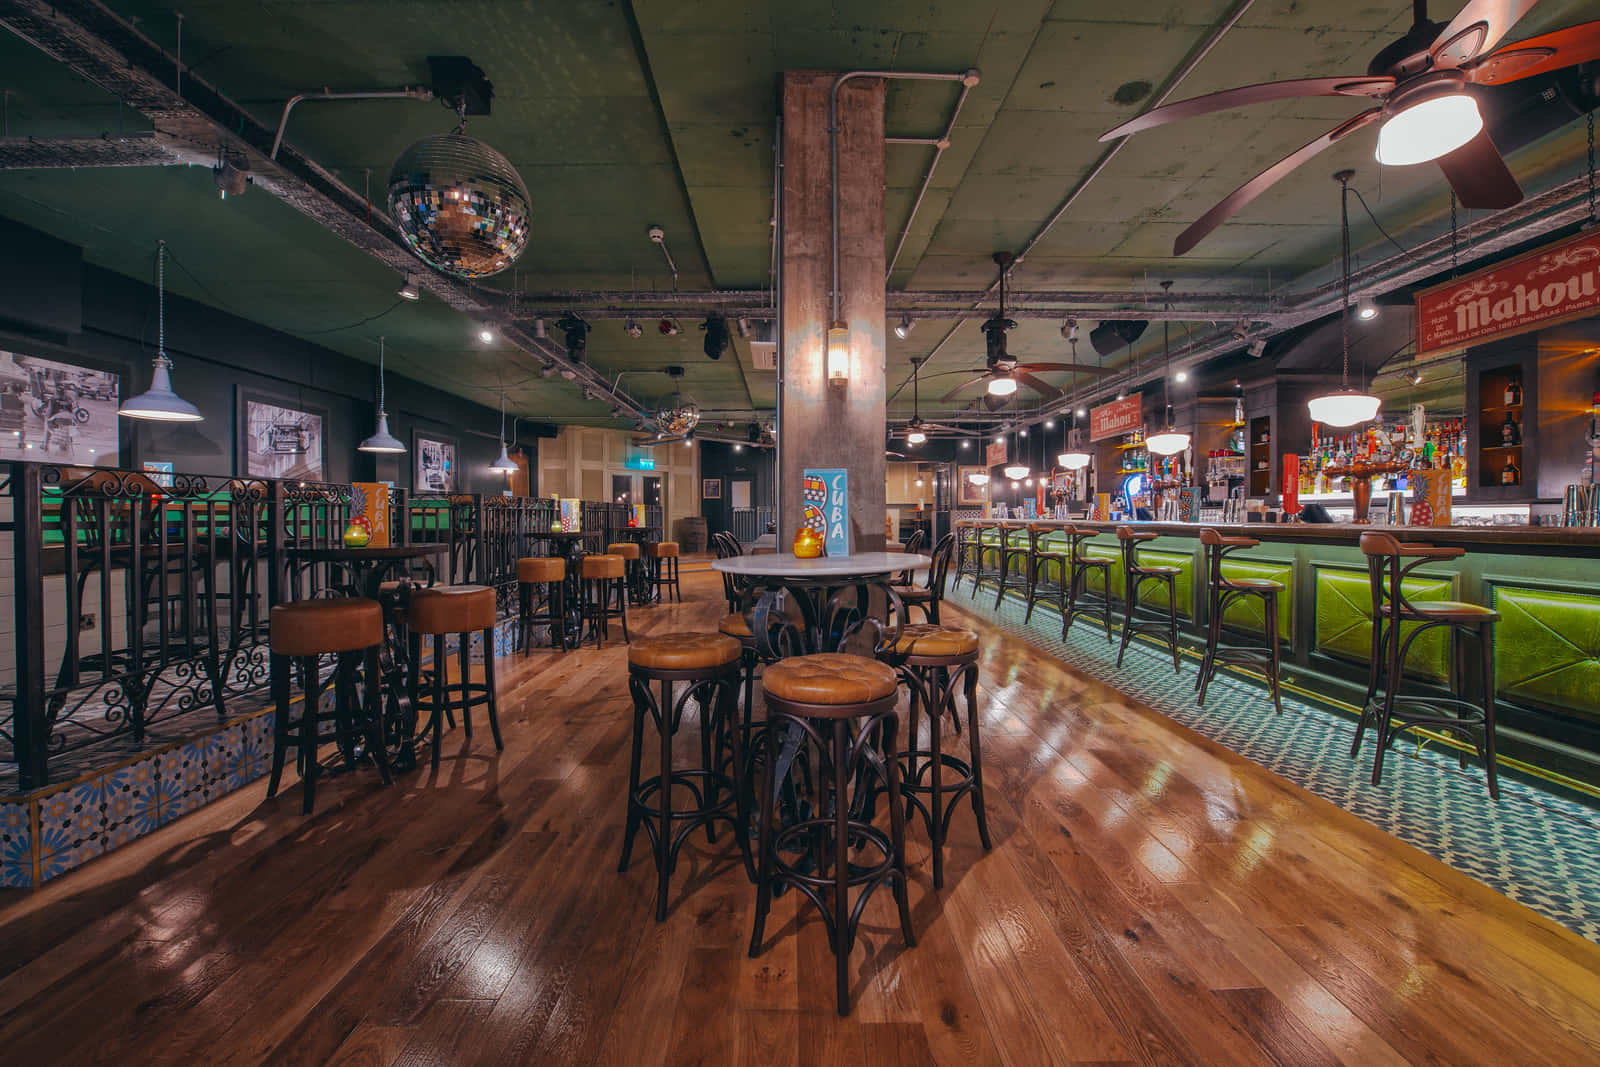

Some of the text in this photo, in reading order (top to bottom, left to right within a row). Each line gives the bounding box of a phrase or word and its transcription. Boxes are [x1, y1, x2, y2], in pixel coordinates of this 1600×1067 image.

[1454, 271, 1597, 333] Mahou
[375, 487, 385, 533] CUBA
[831, 475, 844, 539] CUBA
[1436, 473, 1448, 519] CUBA
